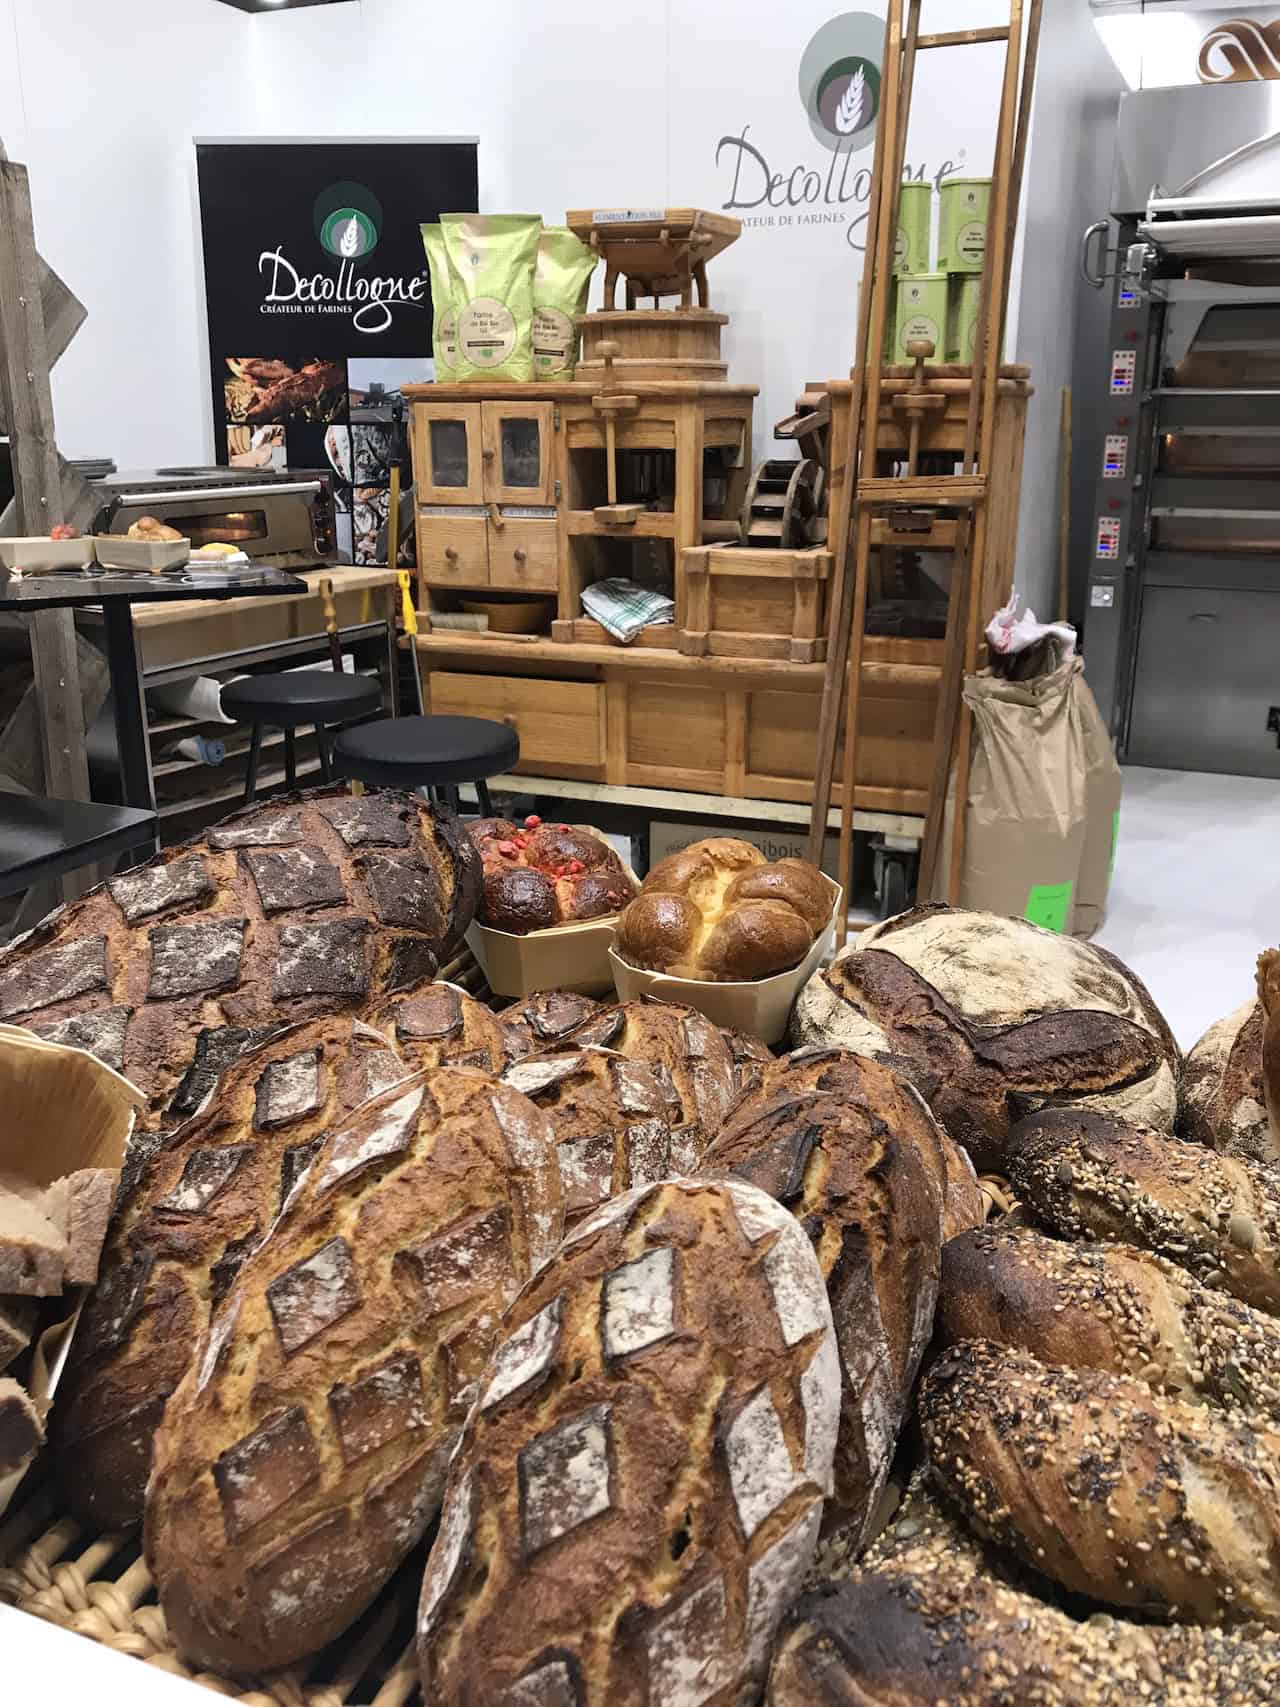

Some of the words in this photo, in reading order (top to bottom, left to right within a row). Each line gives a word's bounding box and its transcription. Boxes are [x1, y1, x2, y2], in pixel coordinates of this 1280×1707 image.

[778, 214, 793, 226] DE
[797, 212, 846, 225] FARINES
[258, 245, 427, 333] Decollogne
[304, 304, 315, 313] DE
[318, 303, 353, 313] FARINES
